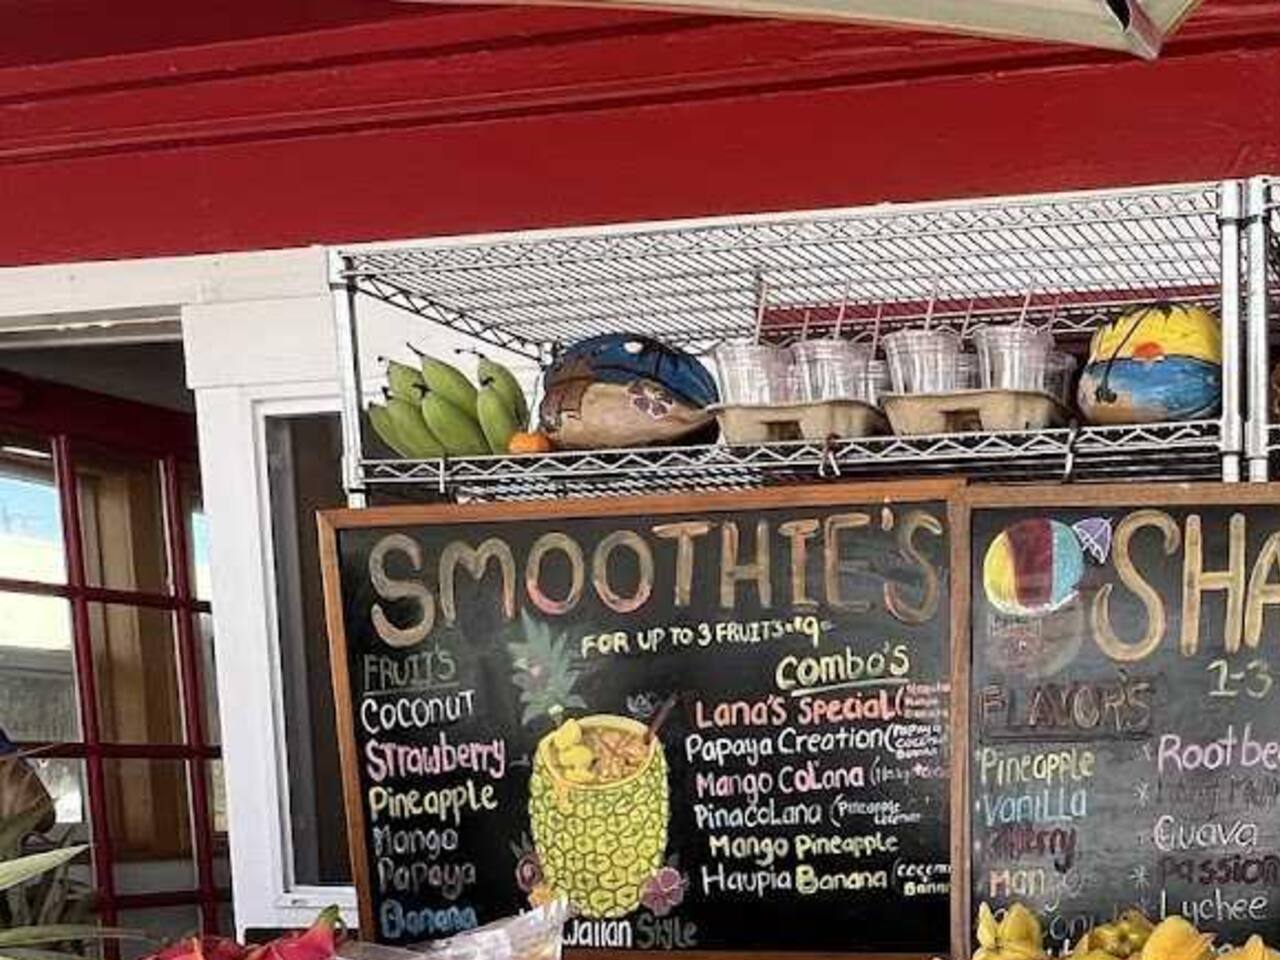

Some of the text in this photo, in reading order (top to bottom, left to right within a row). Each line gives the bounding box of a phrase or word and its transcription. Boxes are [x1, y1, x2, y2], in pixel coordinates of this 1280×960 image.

[369, 503, 943, 647] SMOOTHIE'S
[581, 632, 630, 659] FOR
[637, 627, 665, 652] UP
[672, 628, 692, 646] TO
[698, 622, 711, 647] 3
[776, 641, 910, 690] Combo's
[361, 690, 476, 734] Coconut
[696, 689, 895, 729] Lana's Special
[366, 733, 506, 782] Strawberry
[685, 733, 772, 766] Papaya
[778, 725, 884, 755] Creation
[979, 748, 1095, 787] Pineapple
[369, 779, 498, 825] Pineapple
[696, 771, 773, 805] Mango
[984, 787, 1088, 828] Vanilla
[373, 825, 458, 860] Mango
[709, 832, 899, 867] Mango Pineapple
[1153, 815, 1257, 851] Guava
[377, 857, 477, 899] Papaya
[702, 863, 793, 897] Haupia
[795, 864, 887, 894] Banana
[380, 900, 479, 938] Banana
[1160, 888, 1268, 923] Lychee
